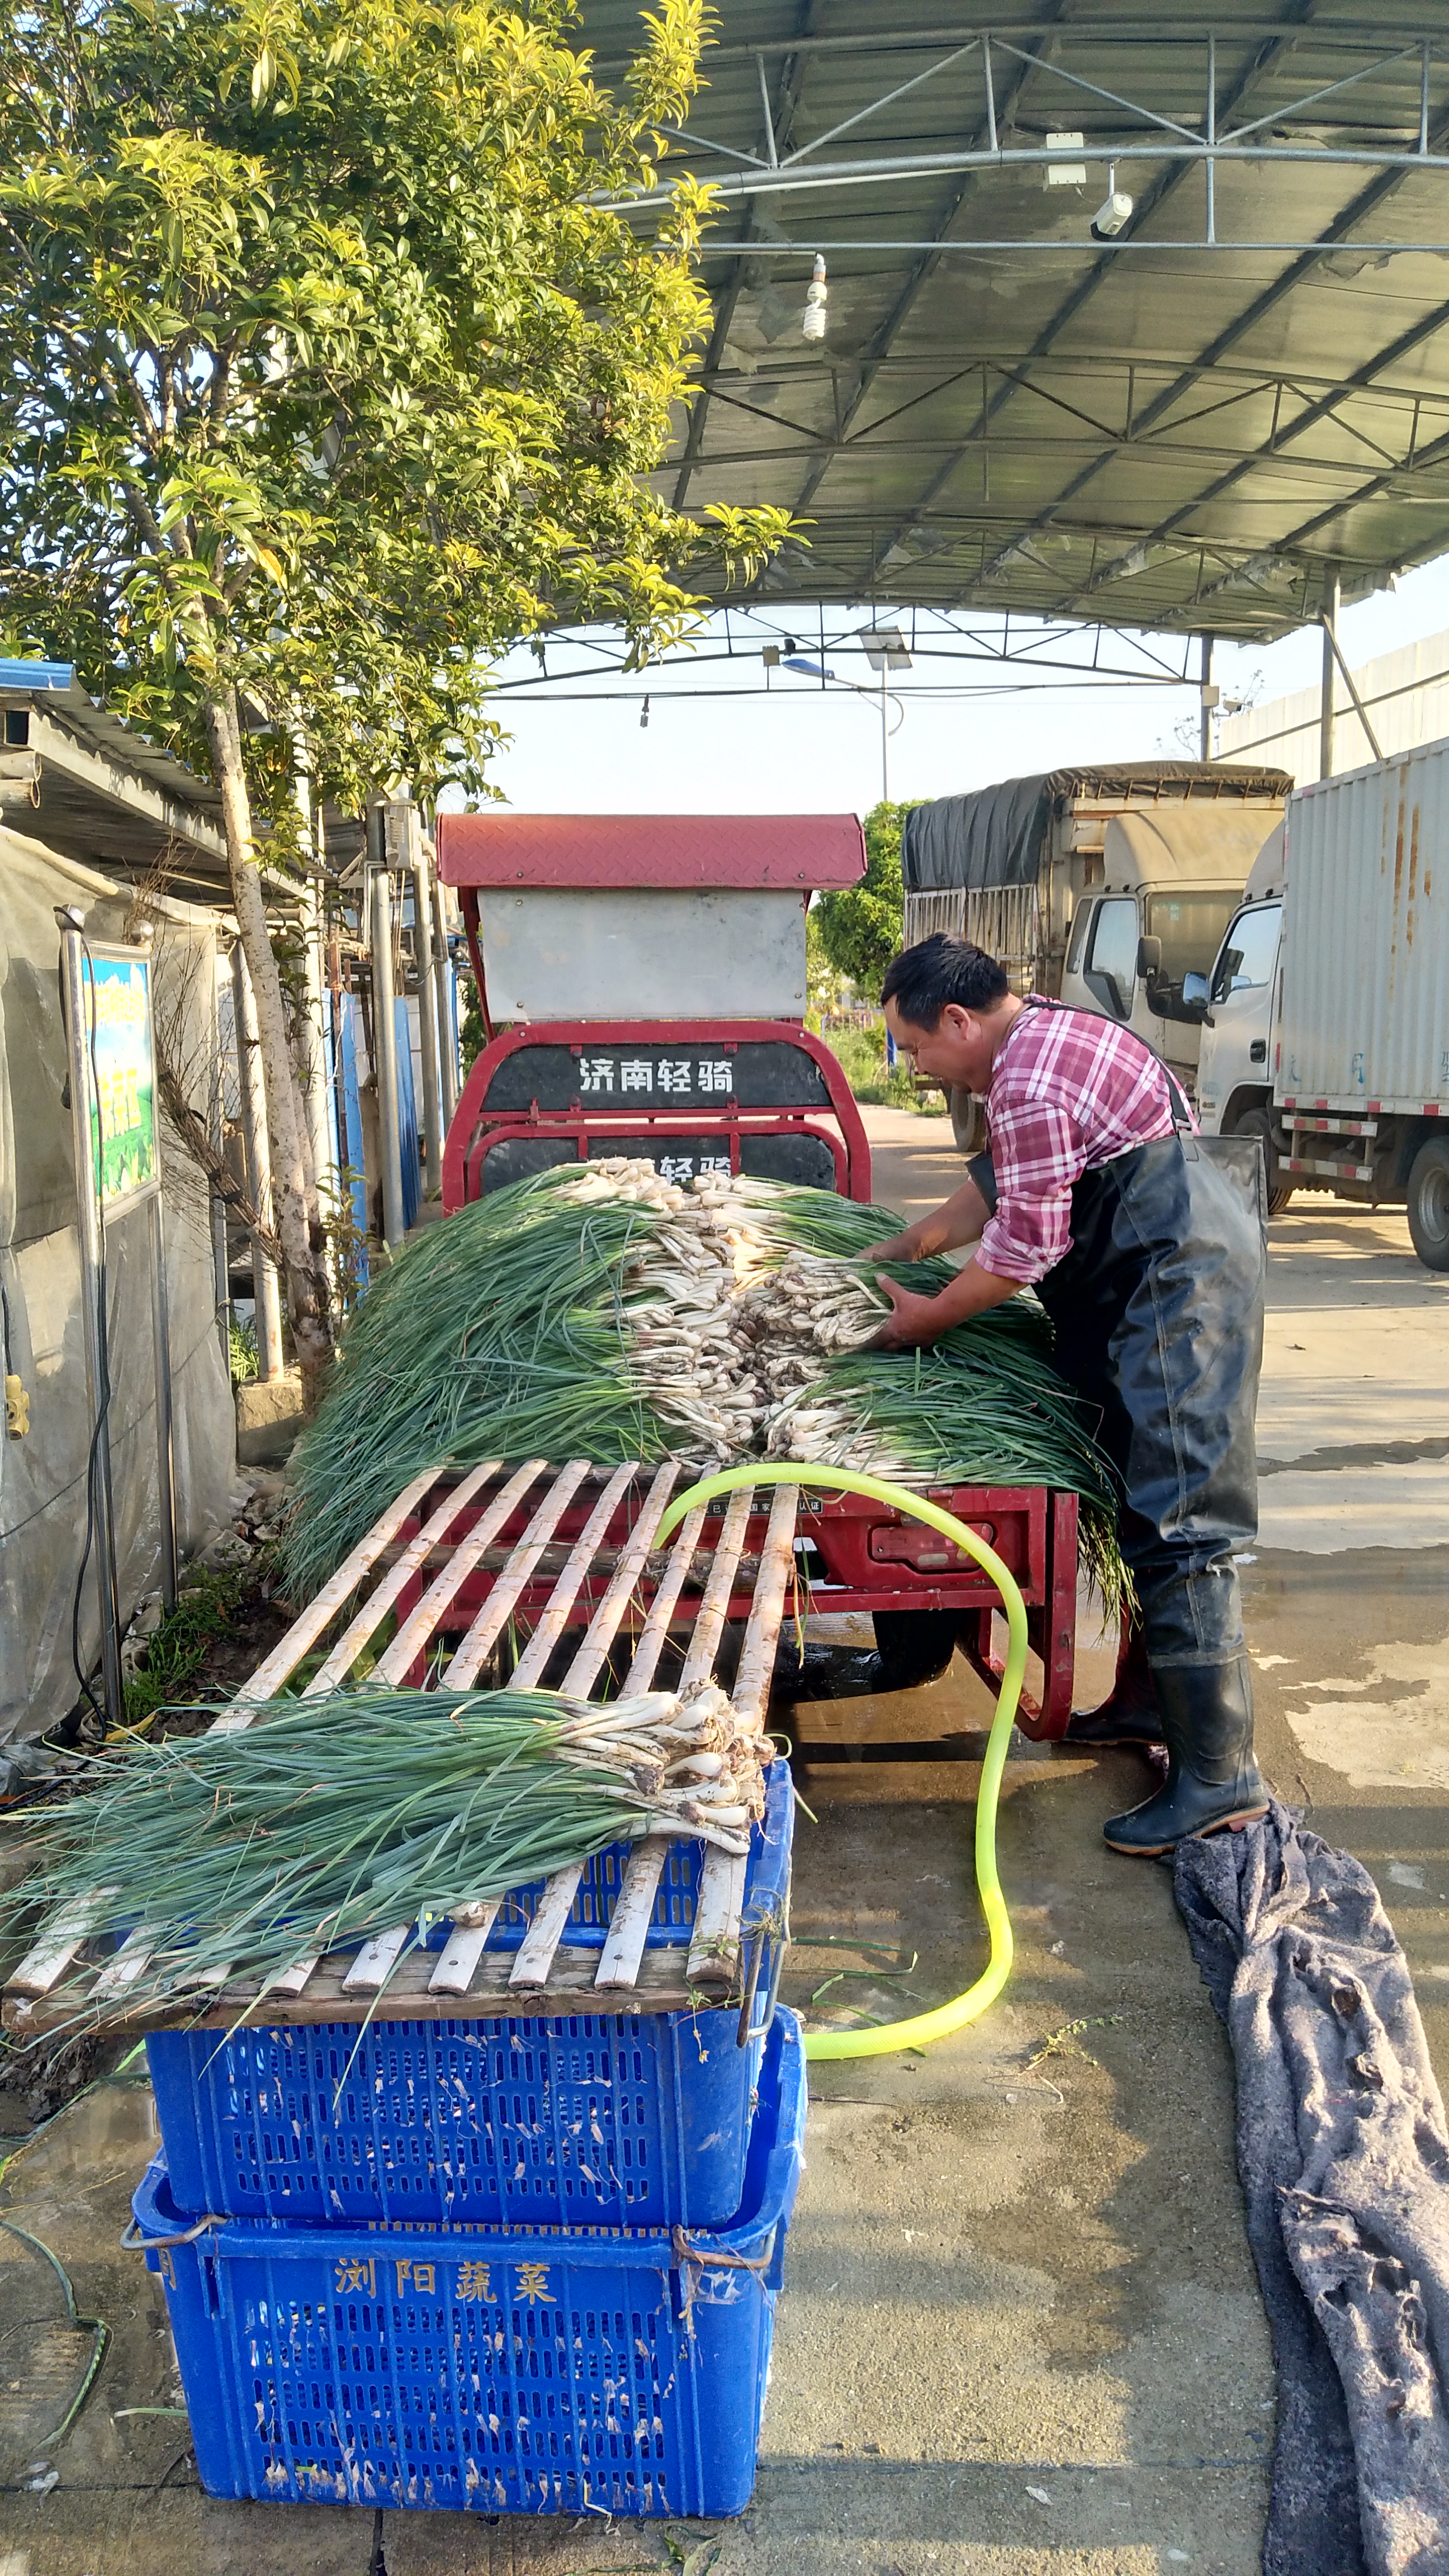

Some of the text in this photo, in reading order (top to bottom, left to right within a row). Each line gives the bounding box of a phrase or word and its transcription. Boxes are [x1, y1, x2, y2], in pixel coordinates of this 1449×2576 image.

[580, 1058, 732, 1092] 济南轻骑
[334, 2258, 557, 2304] 浏阳蔬菜
